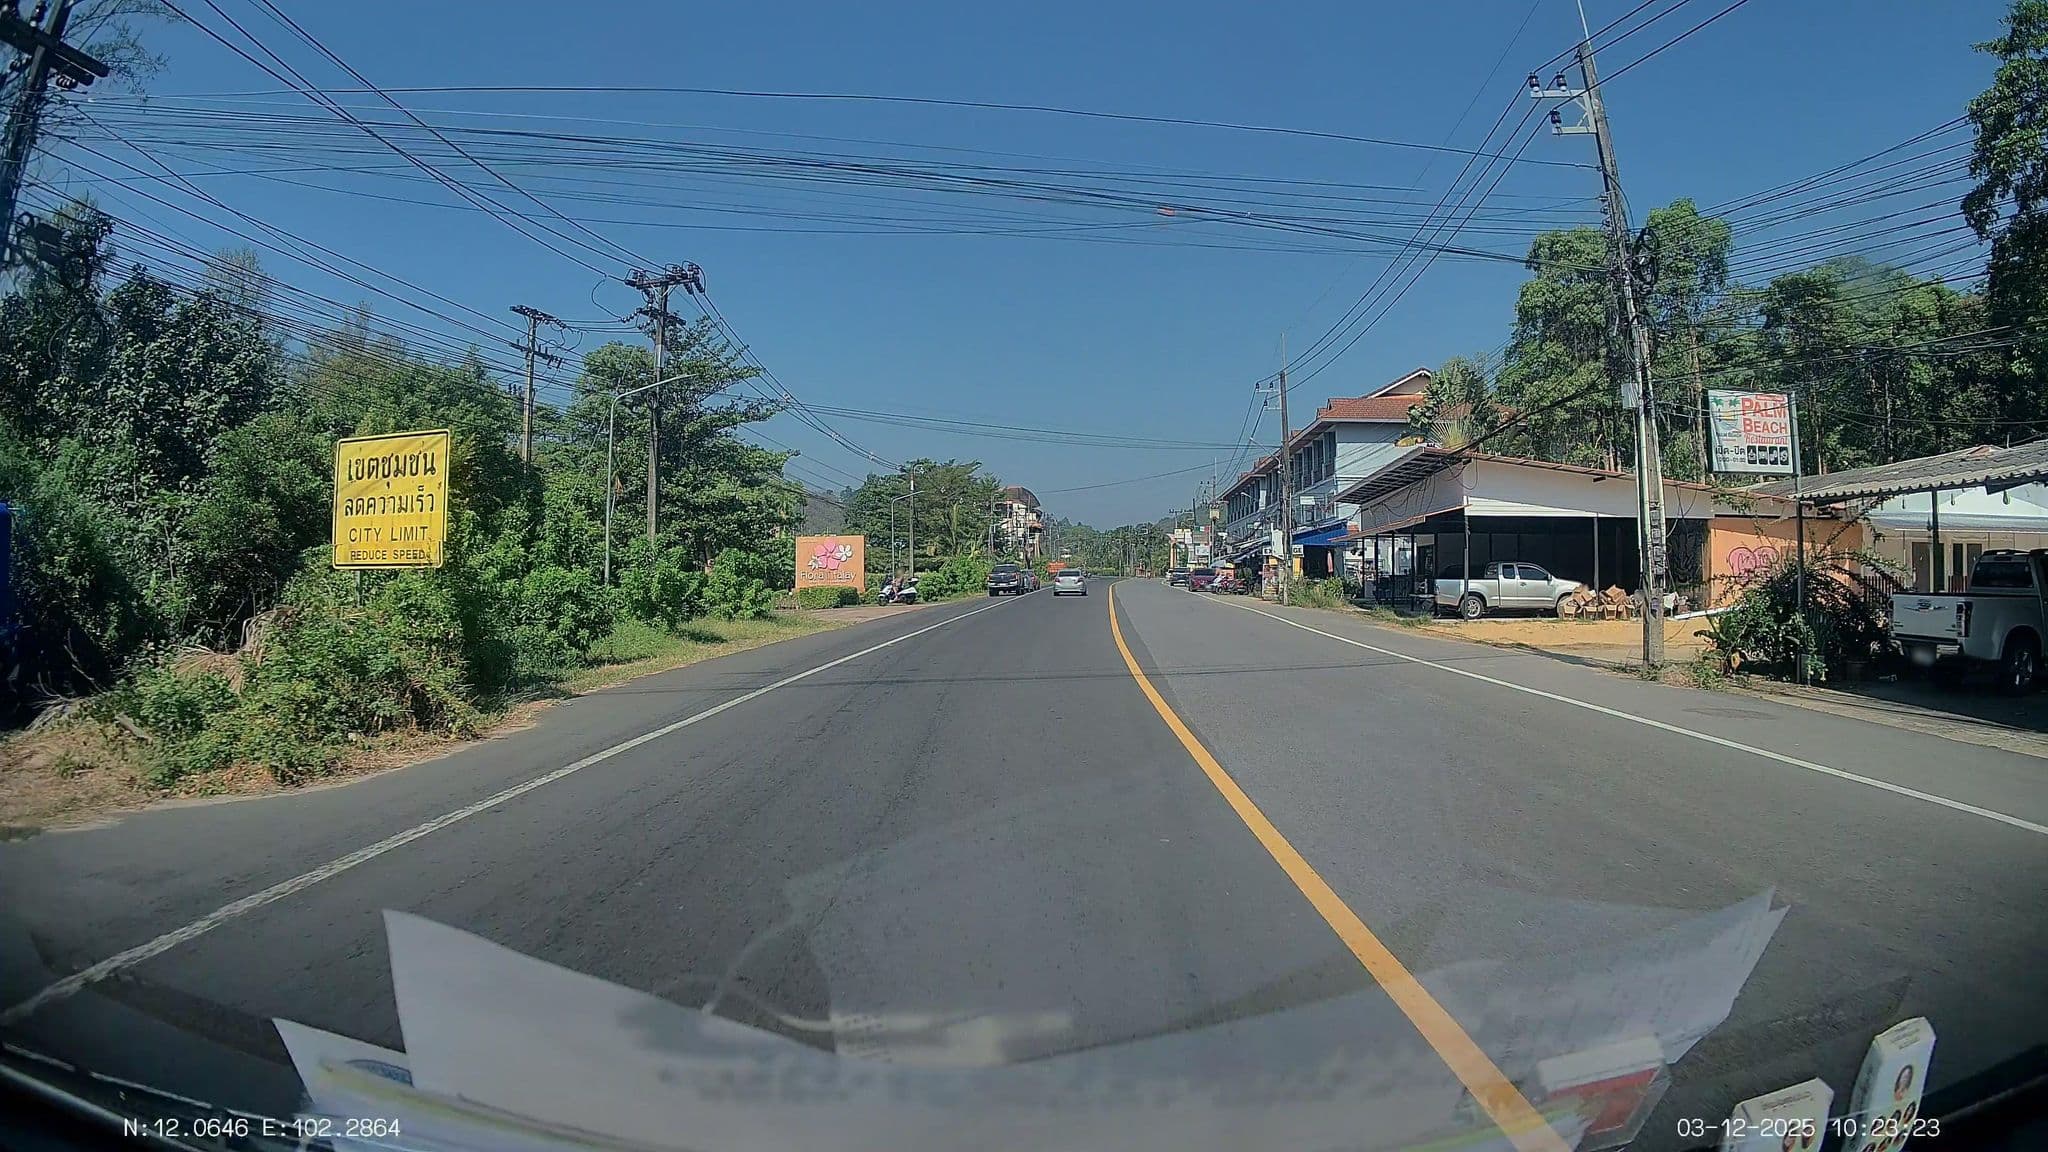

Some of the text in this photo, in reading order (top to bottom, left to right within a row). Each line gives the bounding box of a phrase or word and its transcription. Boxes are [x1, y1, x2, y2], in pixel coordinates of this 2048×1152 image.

[1741, 397, 1786, 418] PALM
[1743, 418, 1788, 434] BEACH
[348, 451, 436, 489] เขตชุมชน
[344, 485, 435, 517] ลดความเร็ว
[349, 526, 428, 543] CITY LIMIT
[350, 549, 426, 561] REDUCE SPEED
[800, 571, 824, 581] Flora
